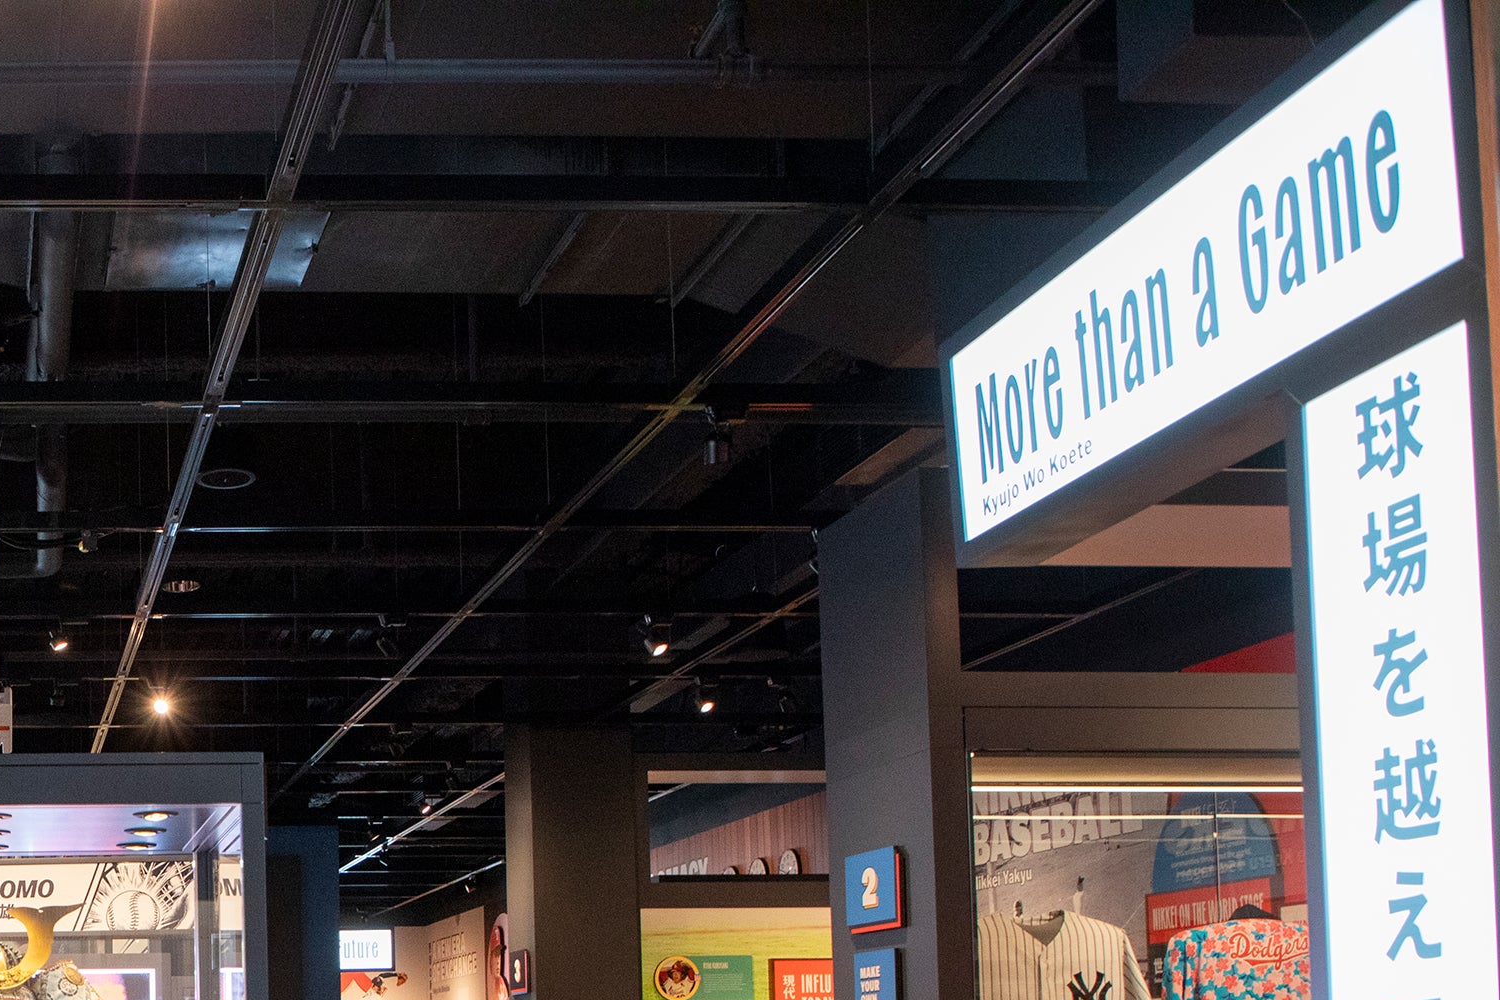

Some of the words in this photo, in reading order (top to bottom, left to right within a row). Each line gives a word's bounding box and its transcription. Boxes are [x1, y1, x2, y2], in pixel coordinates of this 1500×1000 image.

[975, 345, 1063, 486] More
[1074, 268, 1174, 421] than
[1192, 236, 1220, 348] a
[1237, 110, 1400, 315] Game
[982, 481, 1020, 517] Kyujo
[1023, 464, 1045, 490] Wo
[1050, 437, 1093, 477] Koete
[973, 792, 1143, 866] BASEBALL
[861, 866, 879, 909] 2
[1003, 869, 1032, 886] Yakyu
[1152, 906, 1178, 931] NIKKEI
[1179, 904, 1191, 928] ON
[1192, 901, 1207, 925] THE
[340, 939, 379, 959] uture
[1229, 932, 1309, 967] Dodgers
[514, 958, 522, 983] 3
[860, 966, 880, 979] MAKE
[860, 980, 880, 993] YOUR
